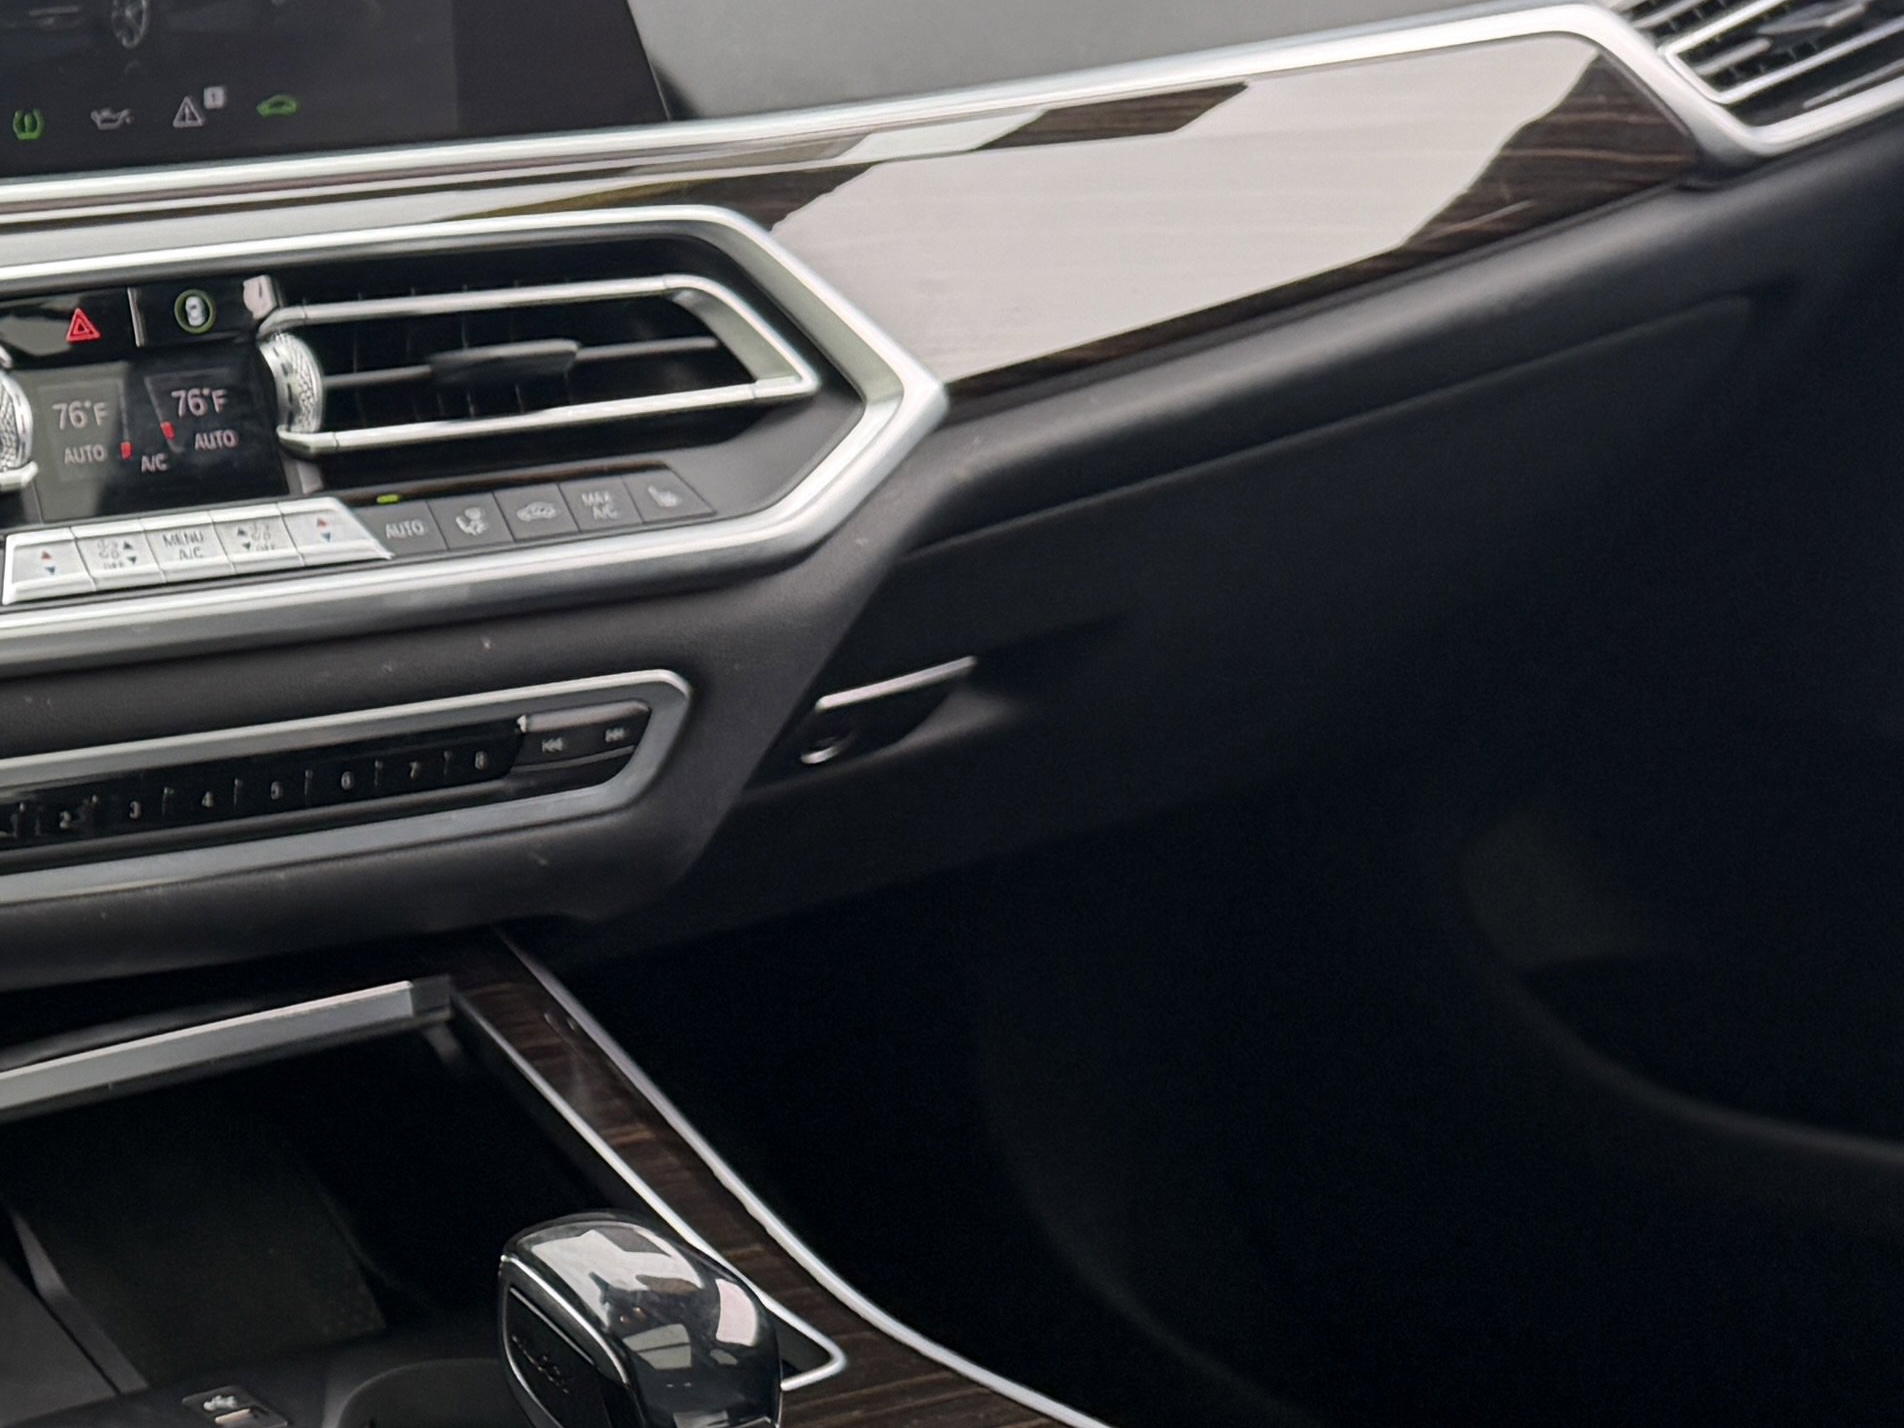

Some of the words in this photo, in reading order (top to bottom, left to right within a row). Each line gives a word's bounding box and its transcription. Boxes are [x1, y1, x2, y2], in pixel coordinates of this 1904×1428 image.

[194, 430, 239, 451] AUTO
[64, 444, 106, 464] AUTO
[140, 453, 169, 472] A/C
[385, 520, 426, 539] AUTO
